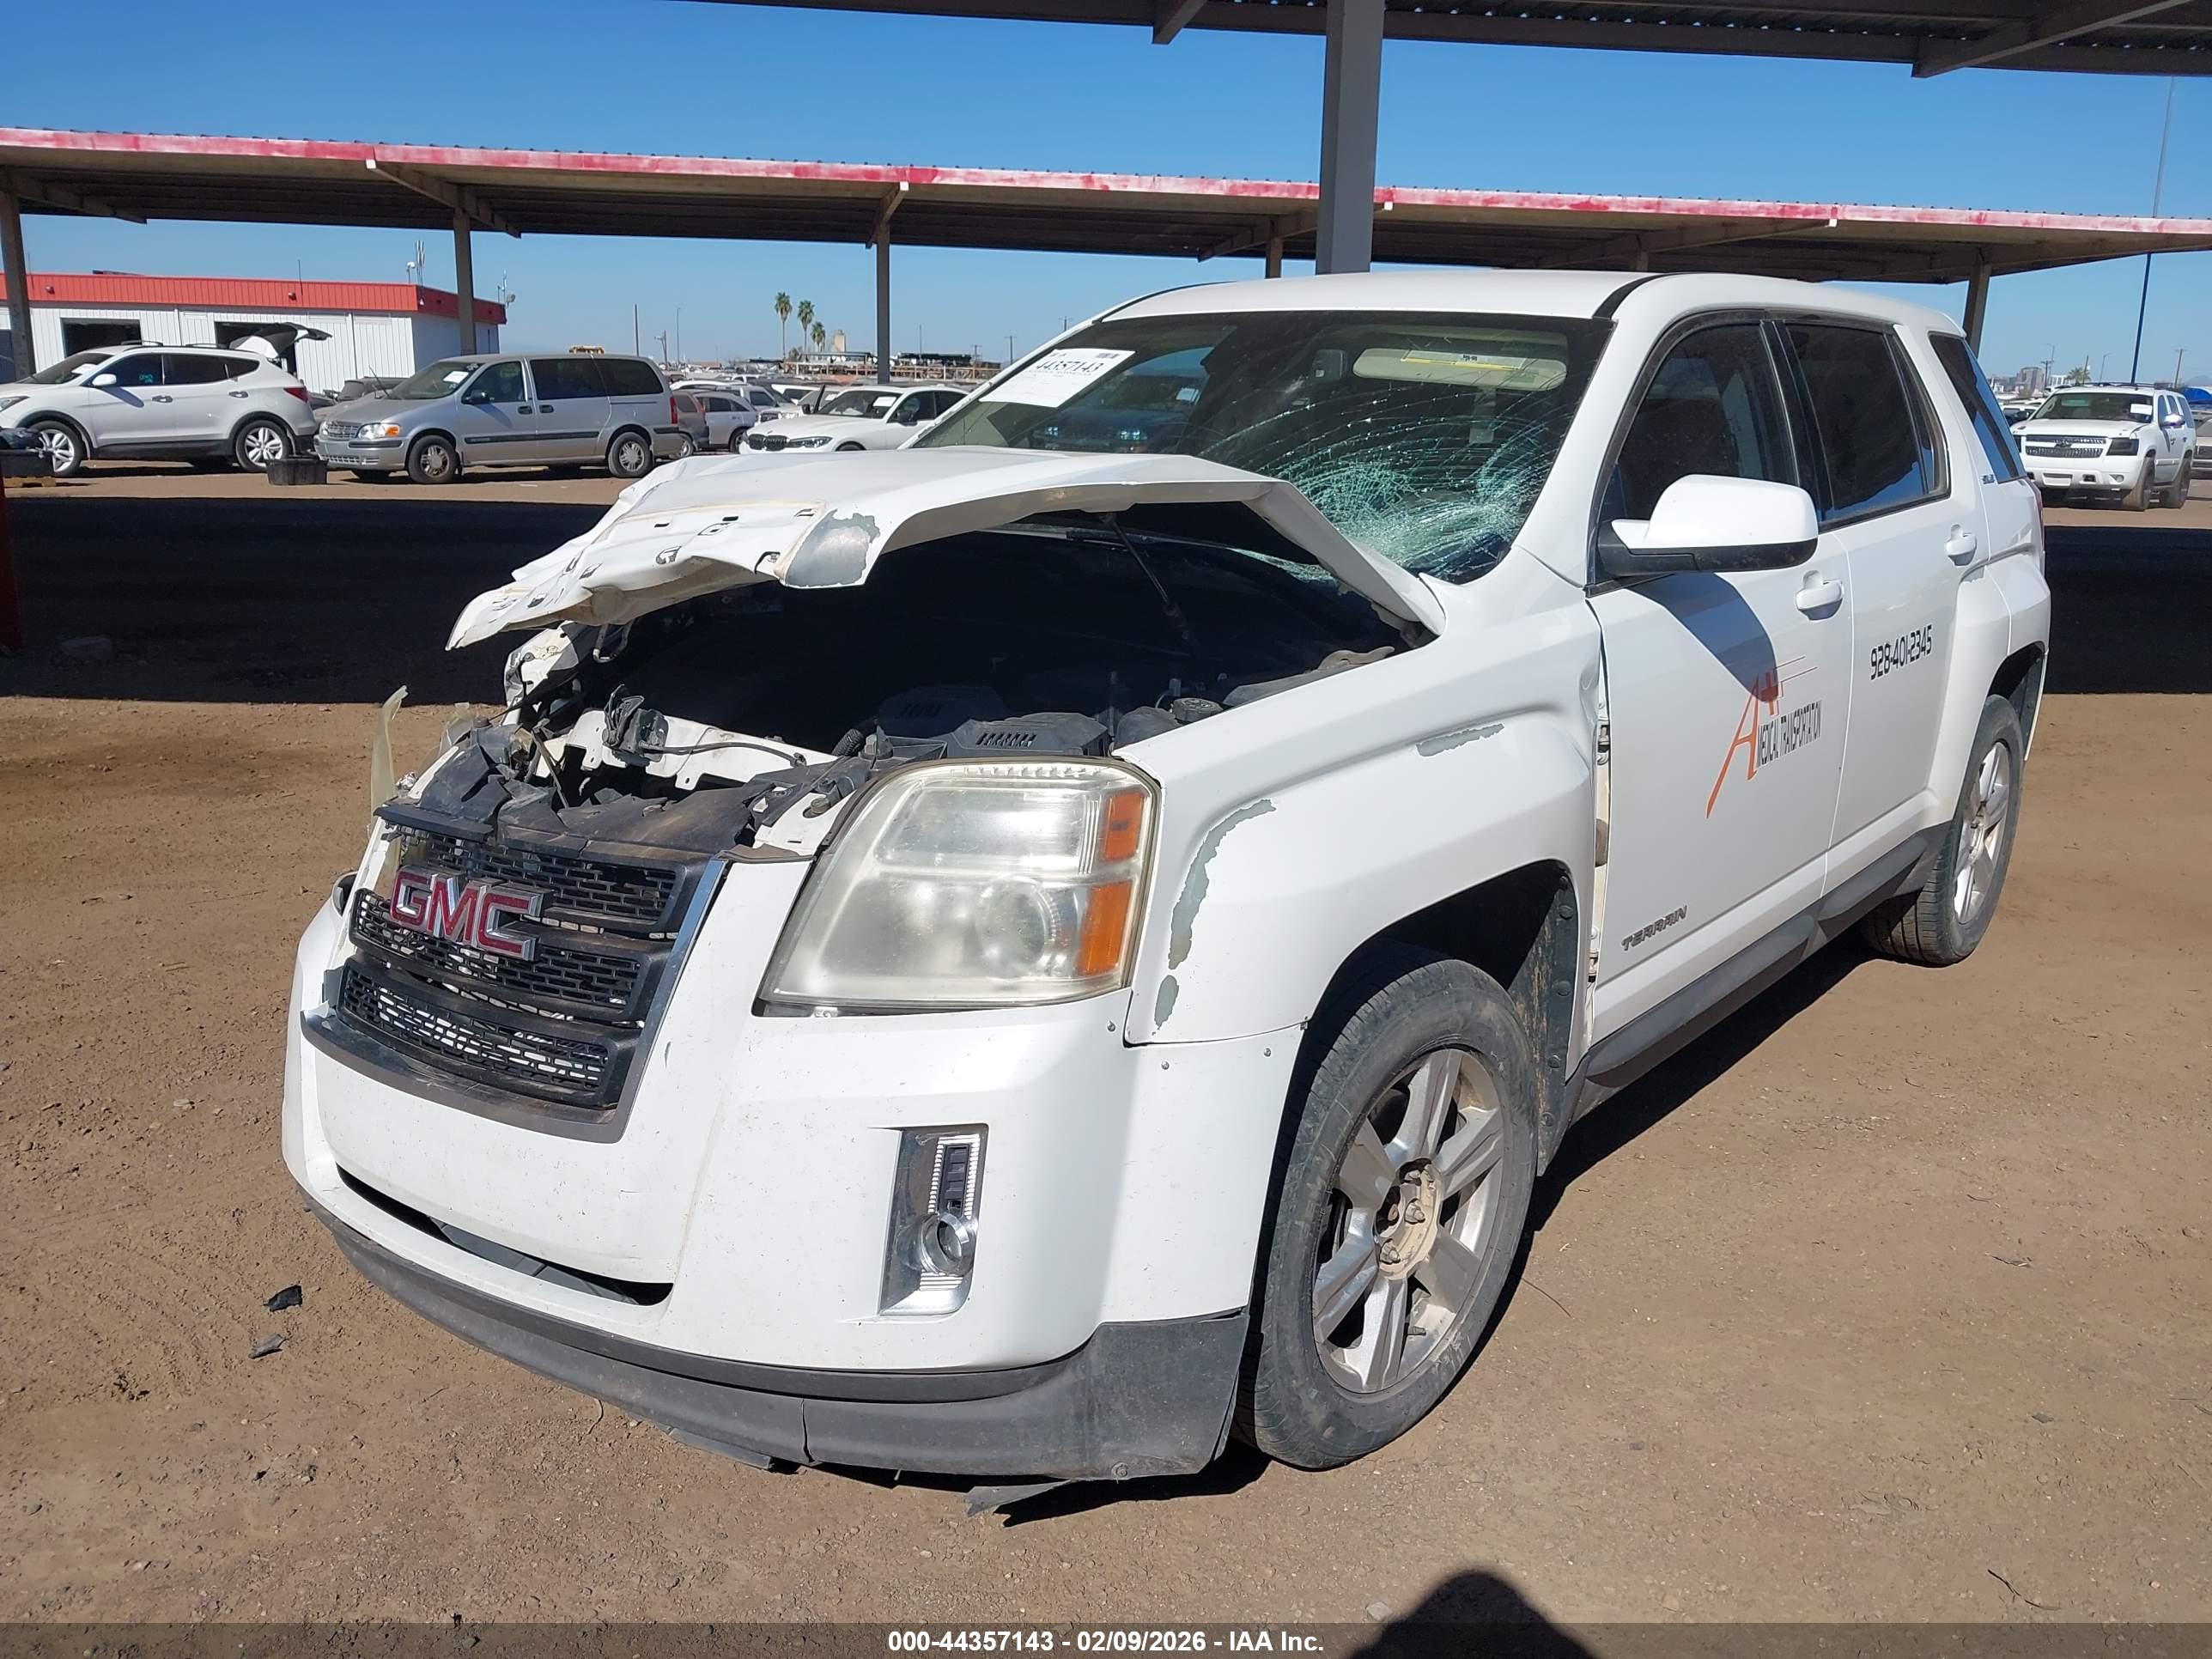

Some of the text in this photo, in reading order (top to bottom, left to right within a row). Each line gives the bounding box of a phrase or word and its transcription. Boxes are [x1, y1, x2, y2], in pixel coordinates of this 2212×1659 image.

[1870, 623, 1932, 680] 928-401-2345
[391, 866, 544, 962] GMC
[1620, 904, 1688, 951] TERRAIN
